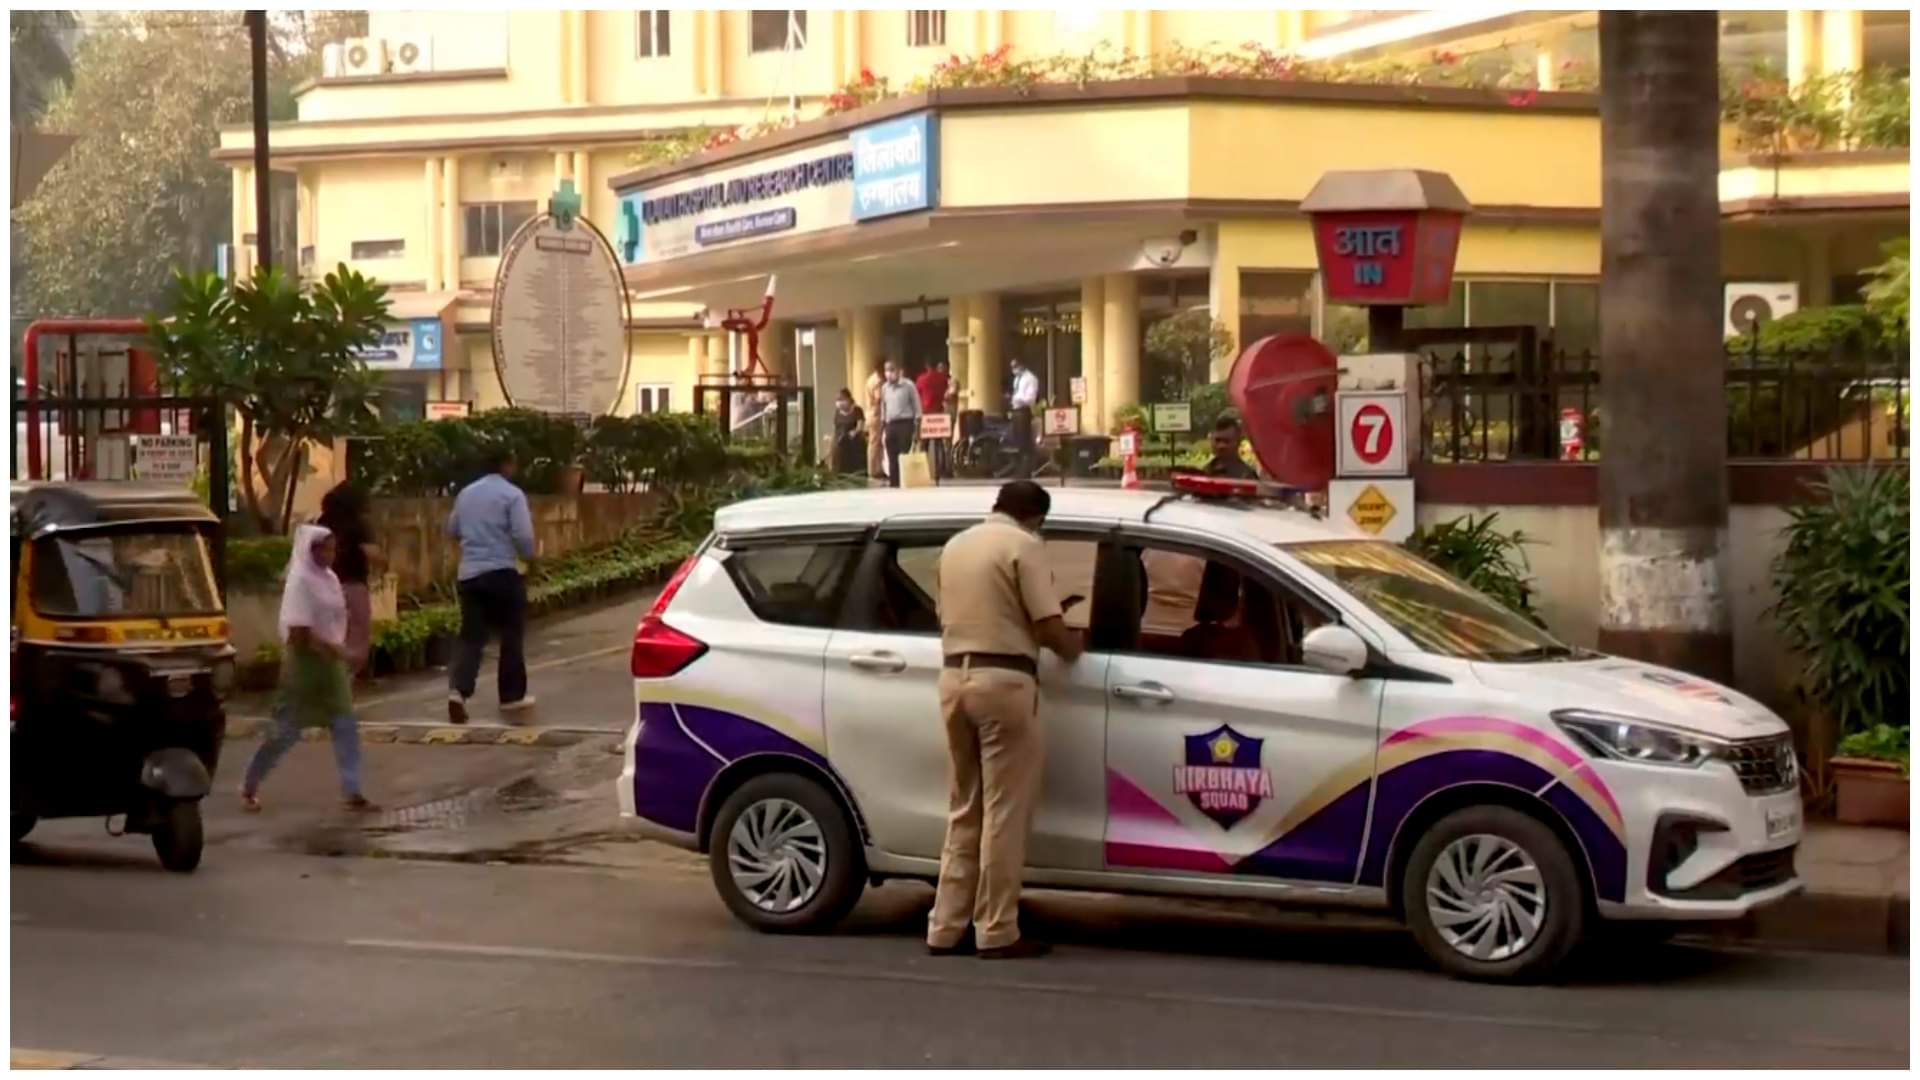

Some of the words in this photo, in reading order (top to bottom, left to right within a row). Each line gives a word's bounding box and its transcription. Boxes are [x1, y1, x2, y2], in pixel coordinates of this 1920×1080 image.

[1334, 224, 1401, 257] आत
[1353, 261, 1384, 286] IN
[141, 438, 154, 448] NO
[155, 437, 192, 448] PARKING
[1359, 415, 1387, 454] 7
[1173, 765, 1273, 799] NIRBHAYA
[1201, 791, 1248, 811] SQUAD
